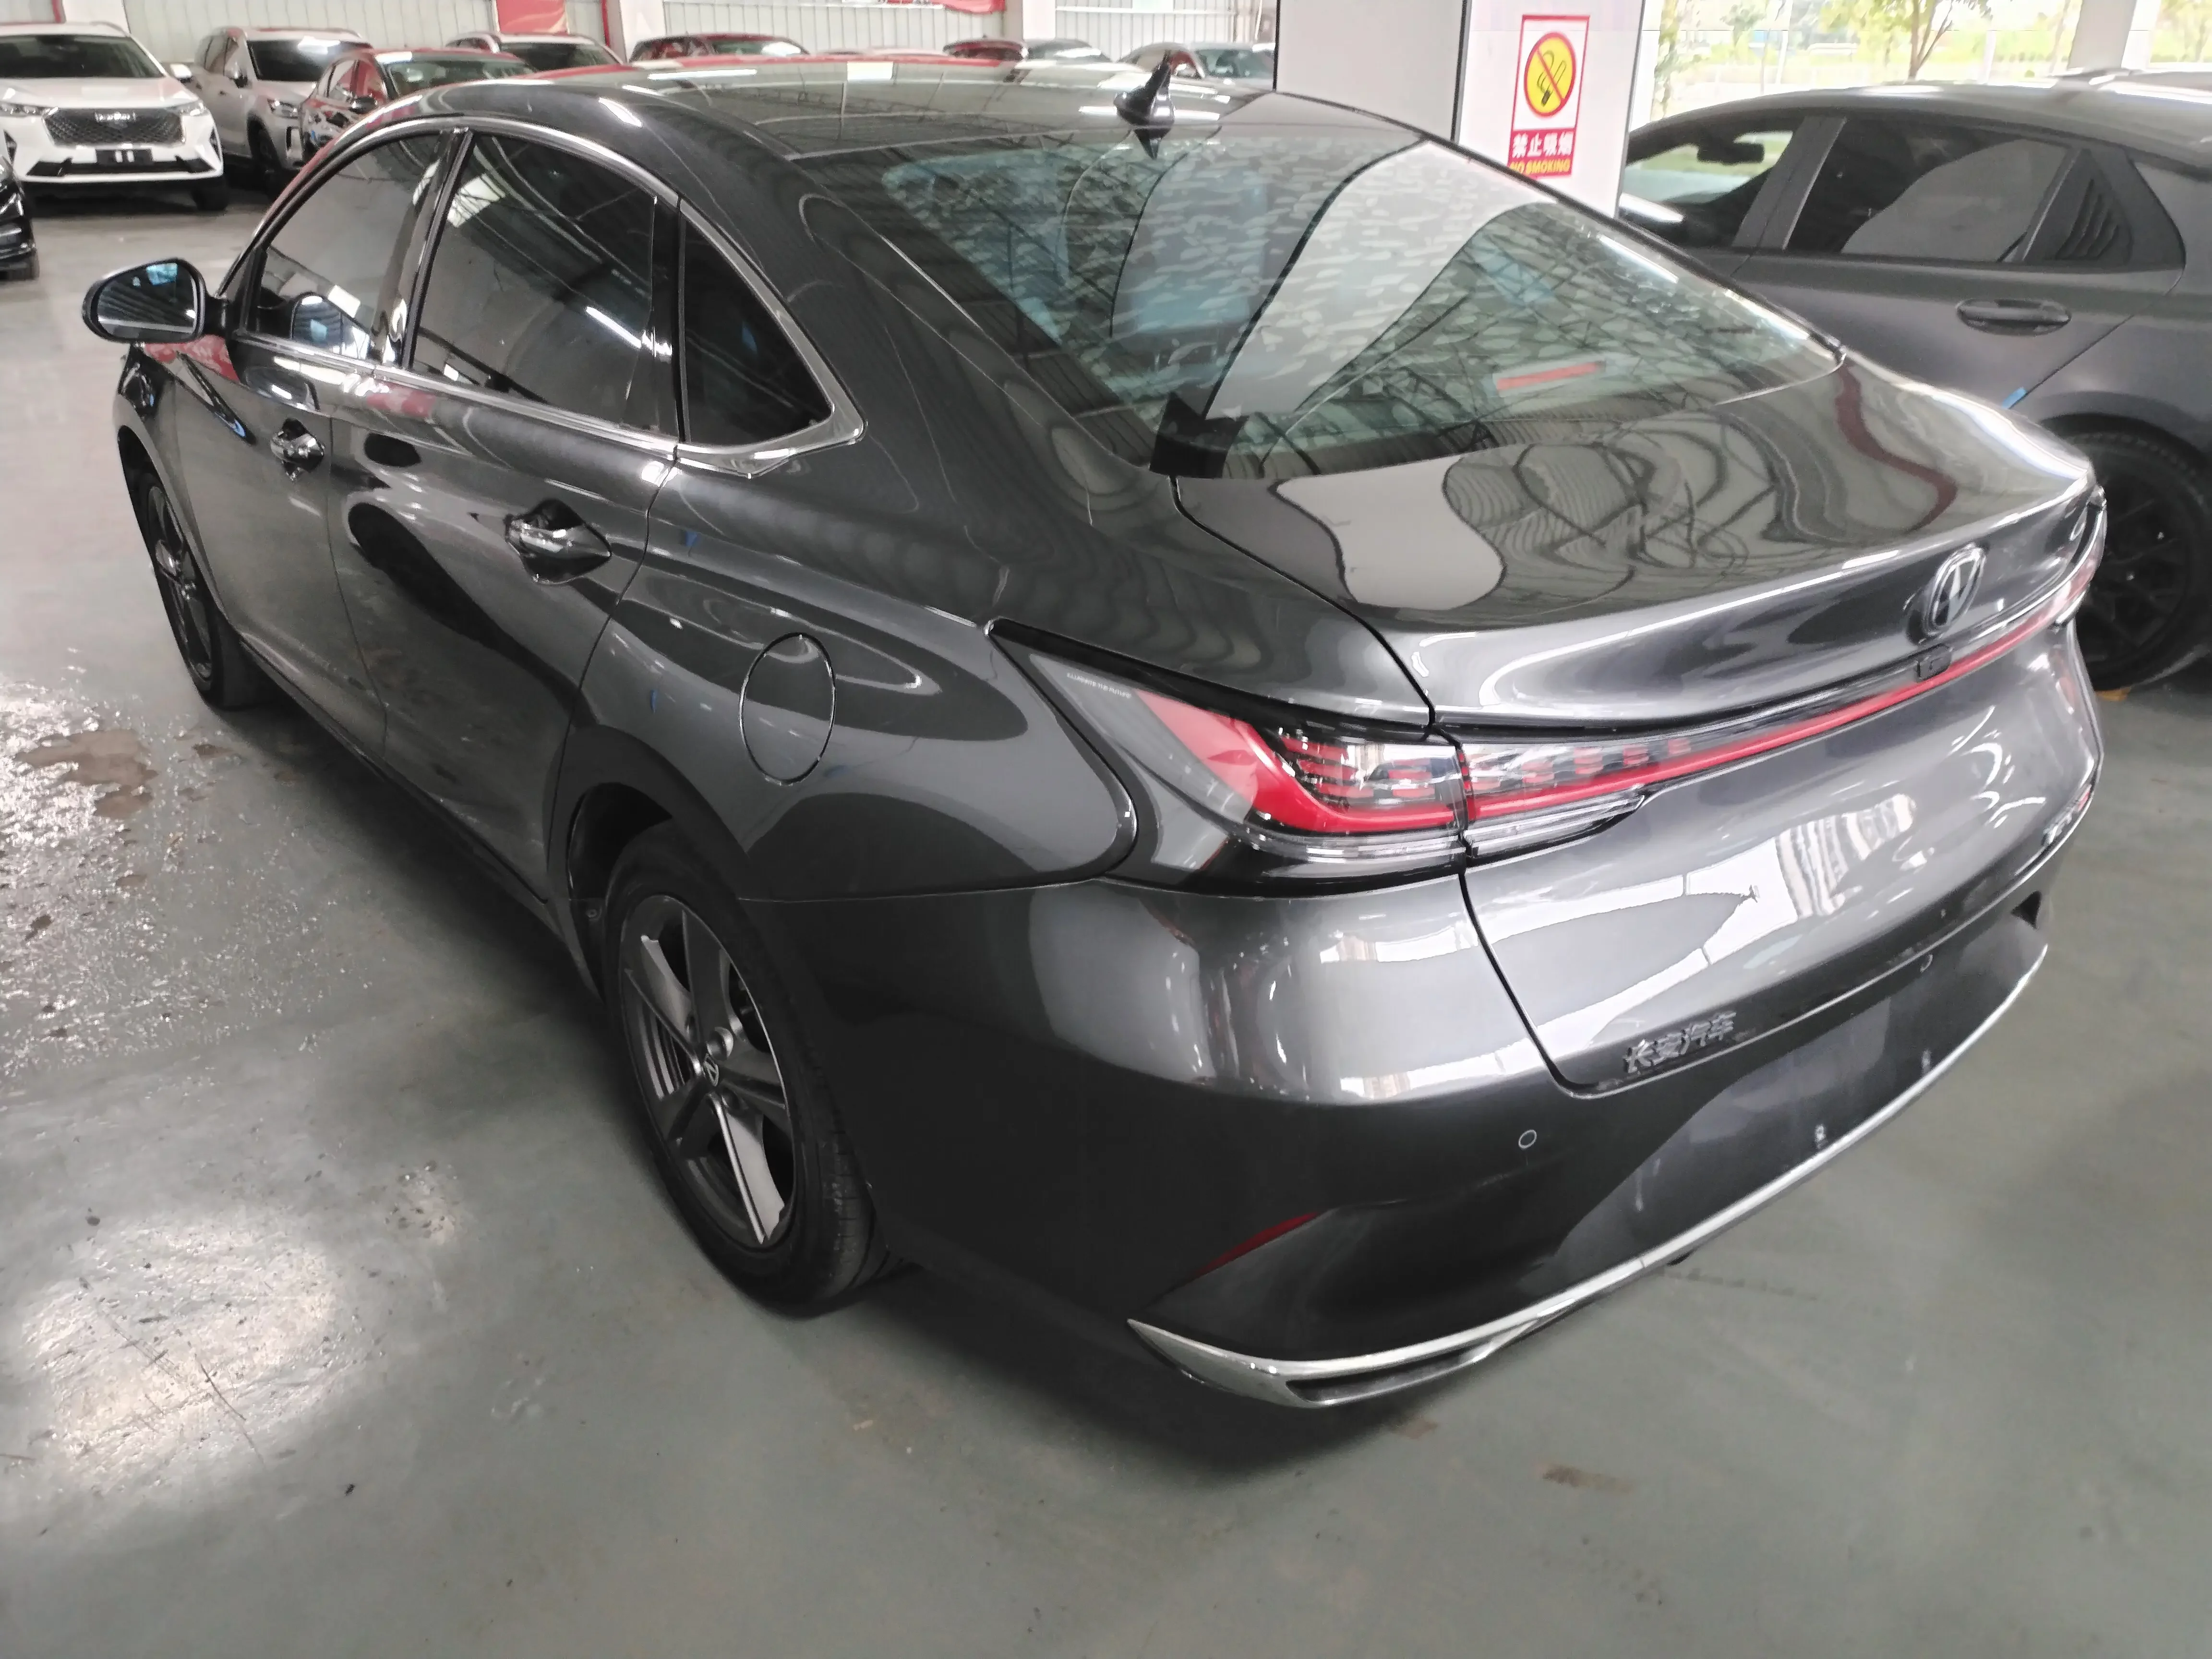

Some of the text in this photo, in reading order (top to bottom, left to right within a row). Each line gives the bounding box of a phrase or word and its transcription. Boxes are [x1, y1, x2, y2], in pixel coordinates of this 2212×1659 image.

[1512, 132, 1574, 157] 禁止吸烟
[1526, 158, 1570, 174] SMOKING
